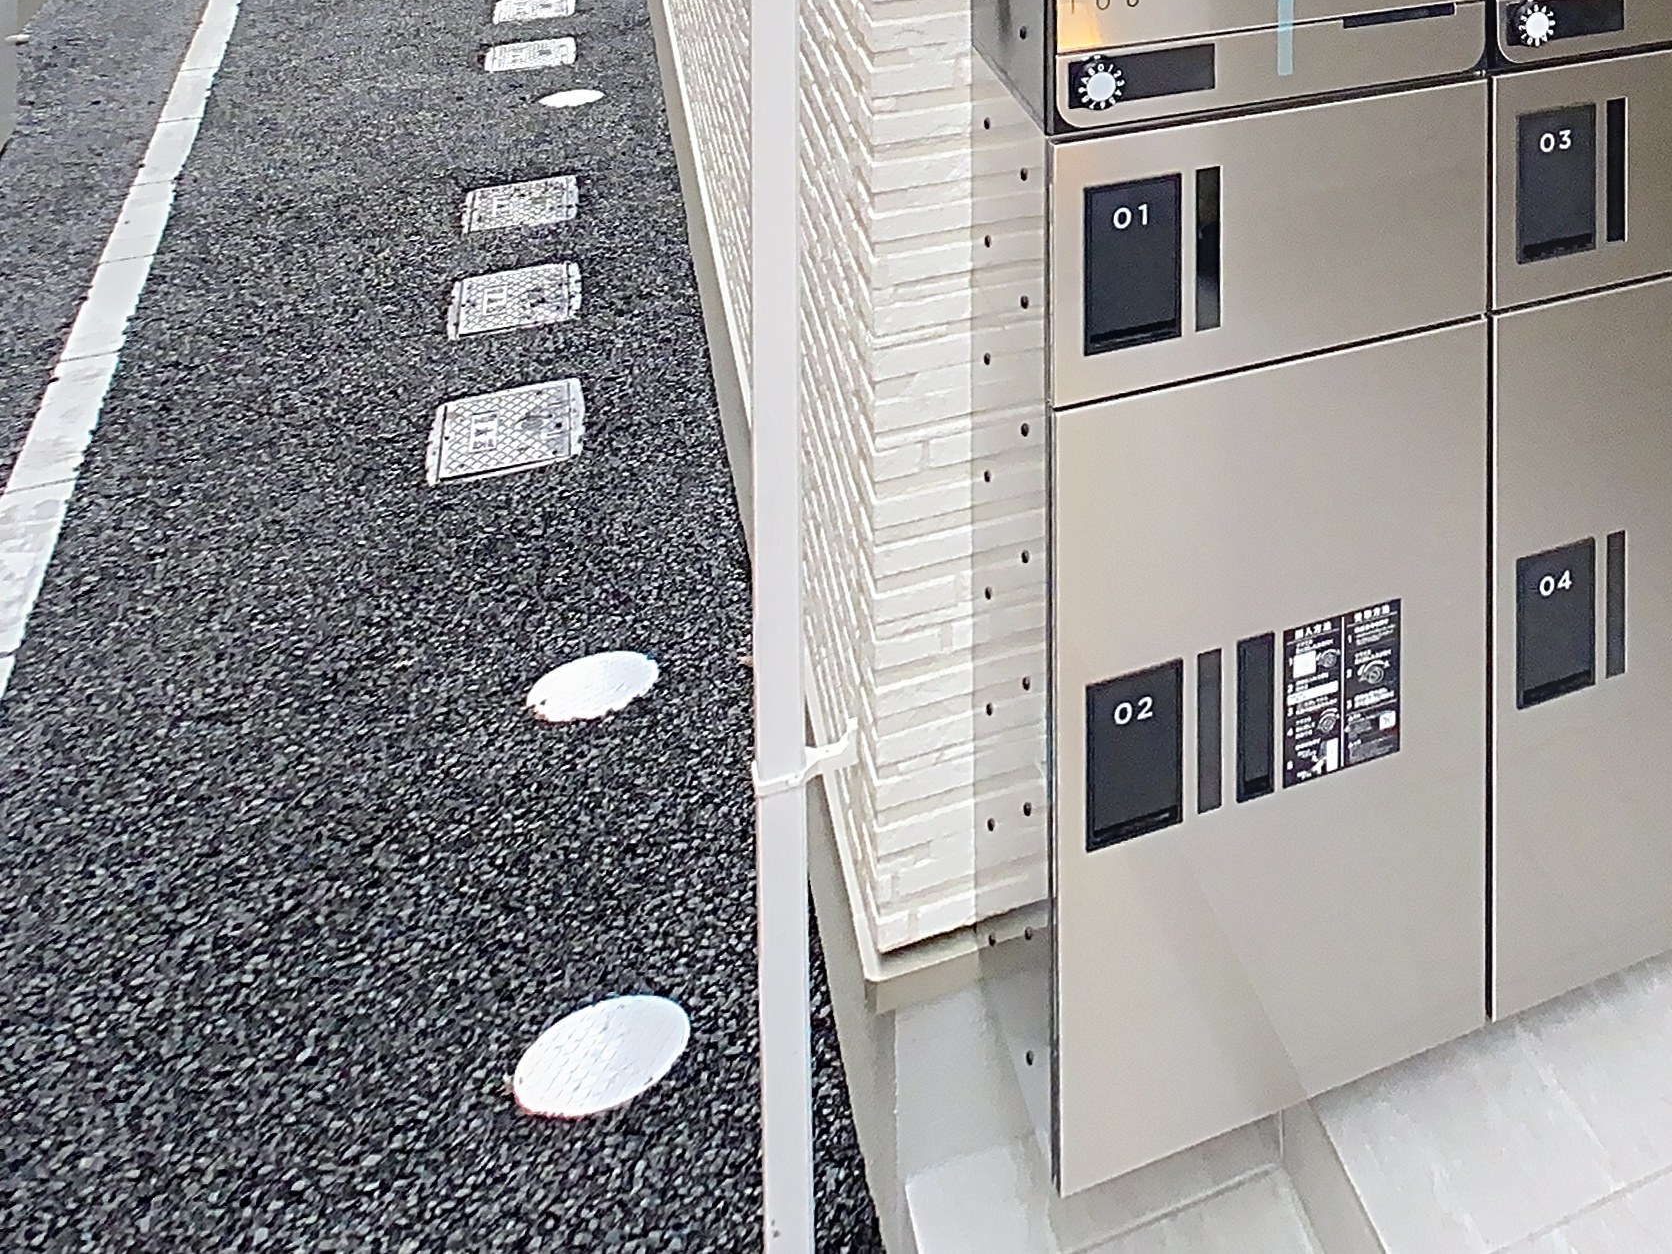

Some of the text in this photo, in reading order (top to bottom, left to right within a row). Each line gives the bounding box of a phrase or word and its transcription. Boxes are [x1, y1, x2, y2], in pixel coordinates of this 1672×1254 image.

[1538, 129, 1573, 154] 03
[1111, 202, 1151, 230] 01
[1538, 570, 1574, 598] 04
[1113, 696, 1154, 726] 02
